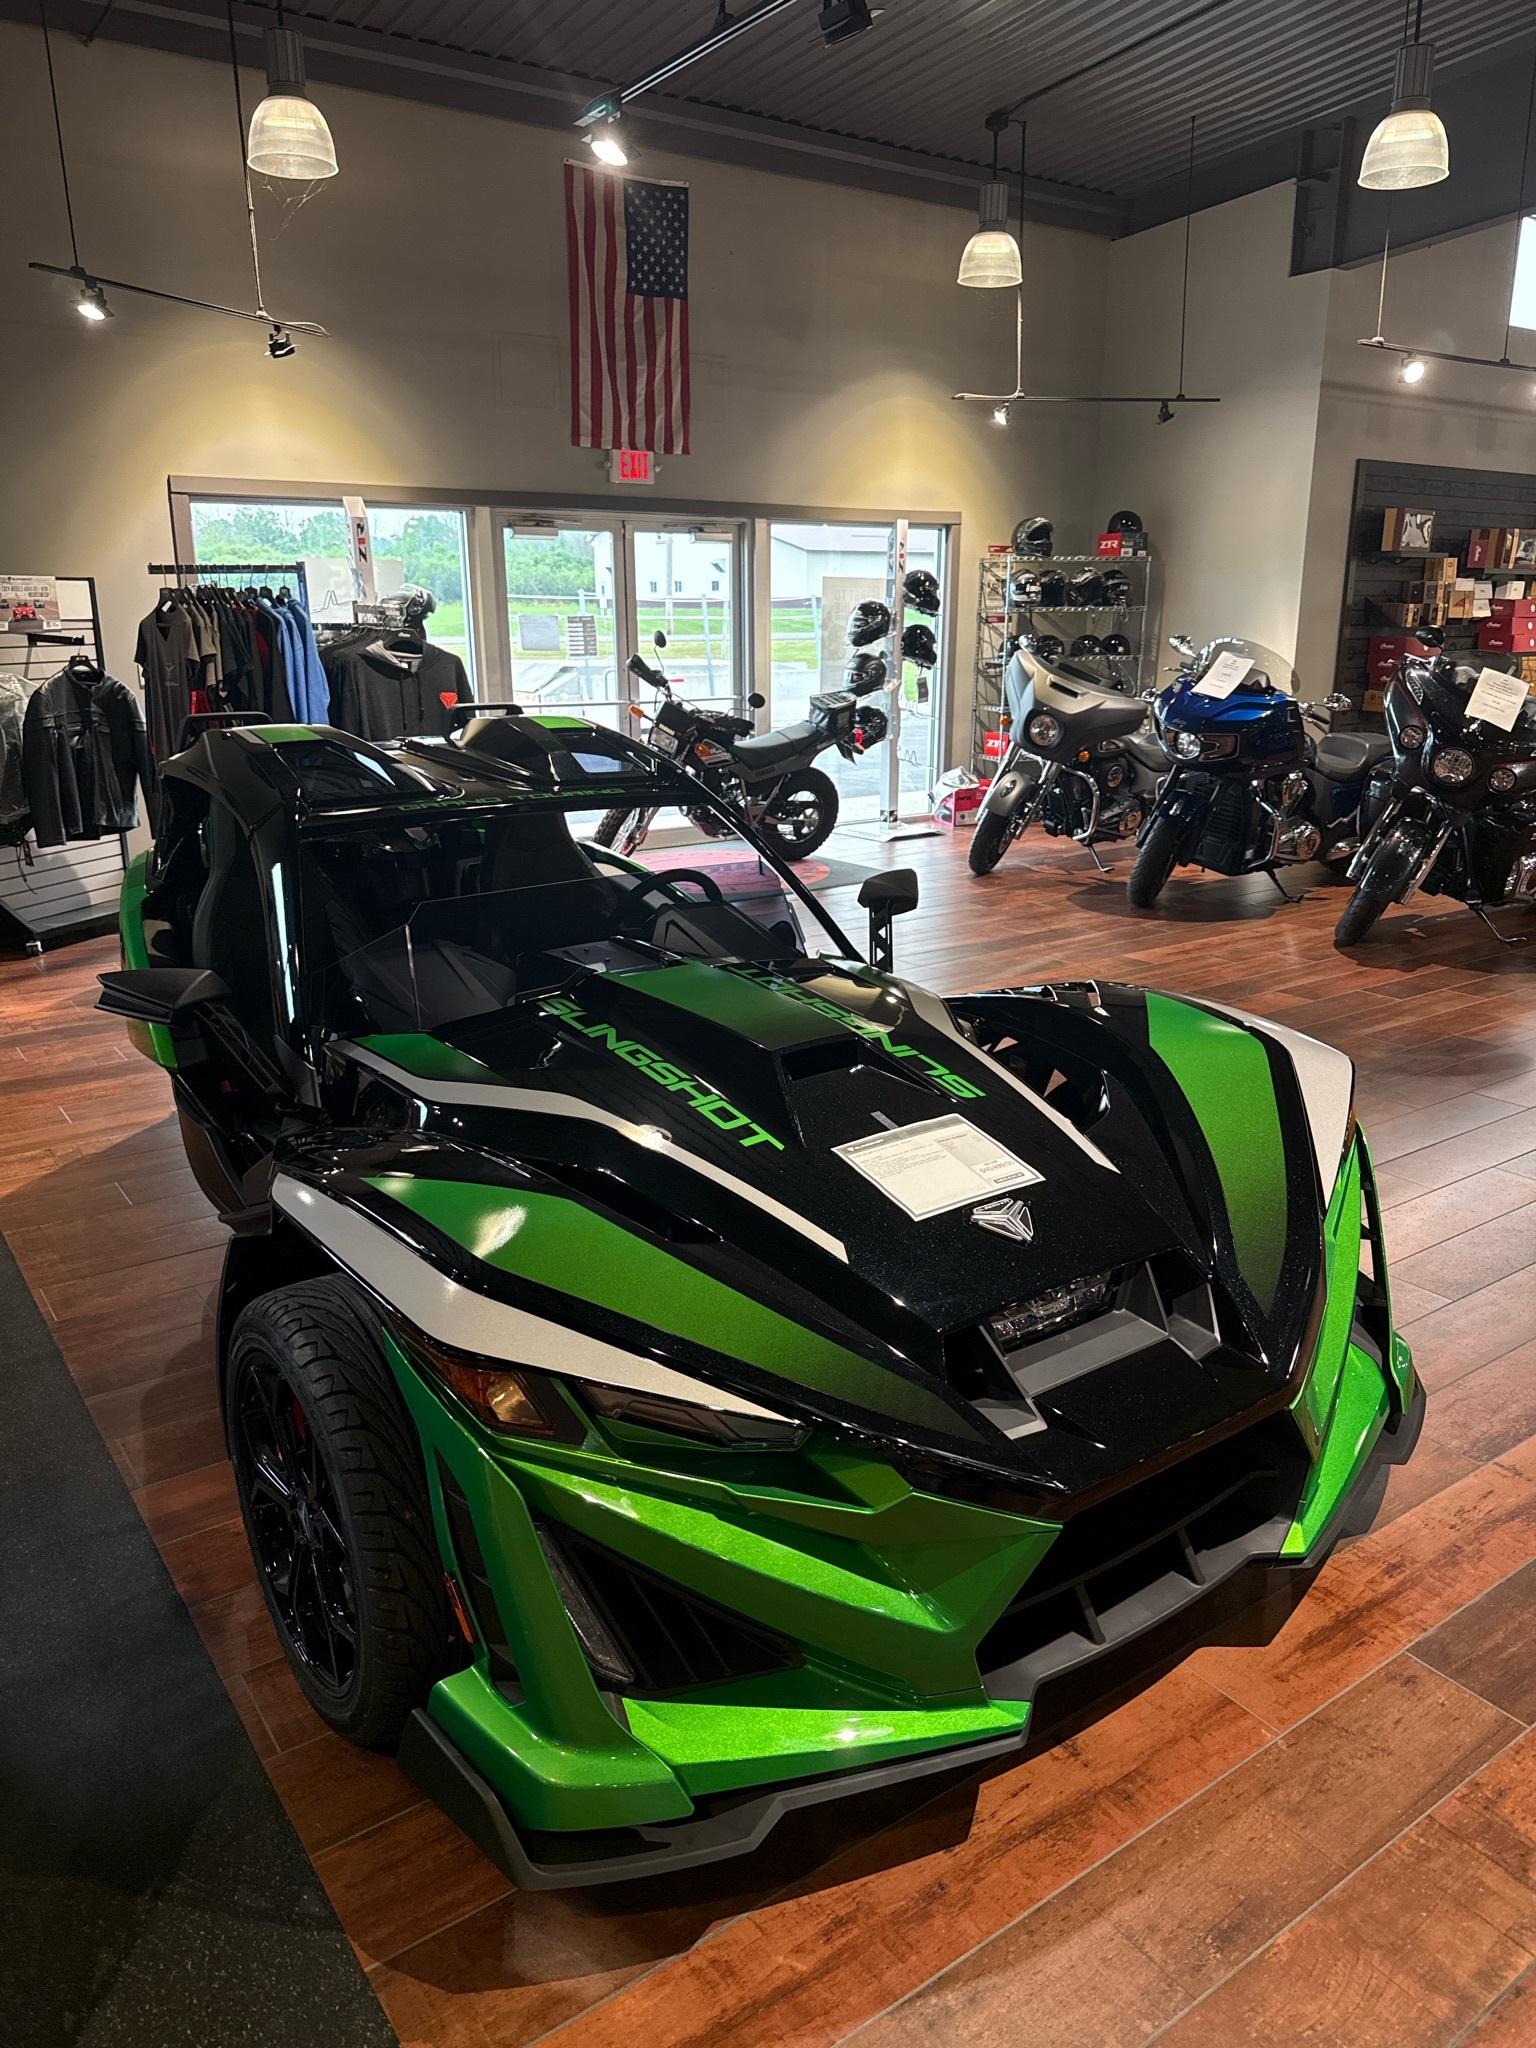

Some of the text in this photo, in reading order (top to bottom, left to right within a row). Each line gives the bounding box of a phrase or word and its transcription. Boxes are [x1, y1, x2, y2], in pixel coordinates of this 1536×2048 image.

[620, 451, 649, 480] EXIT
[398, 788, 625, 811] GRAND TOURING
[539, 998, 785, 1152] SLINGSHOT
